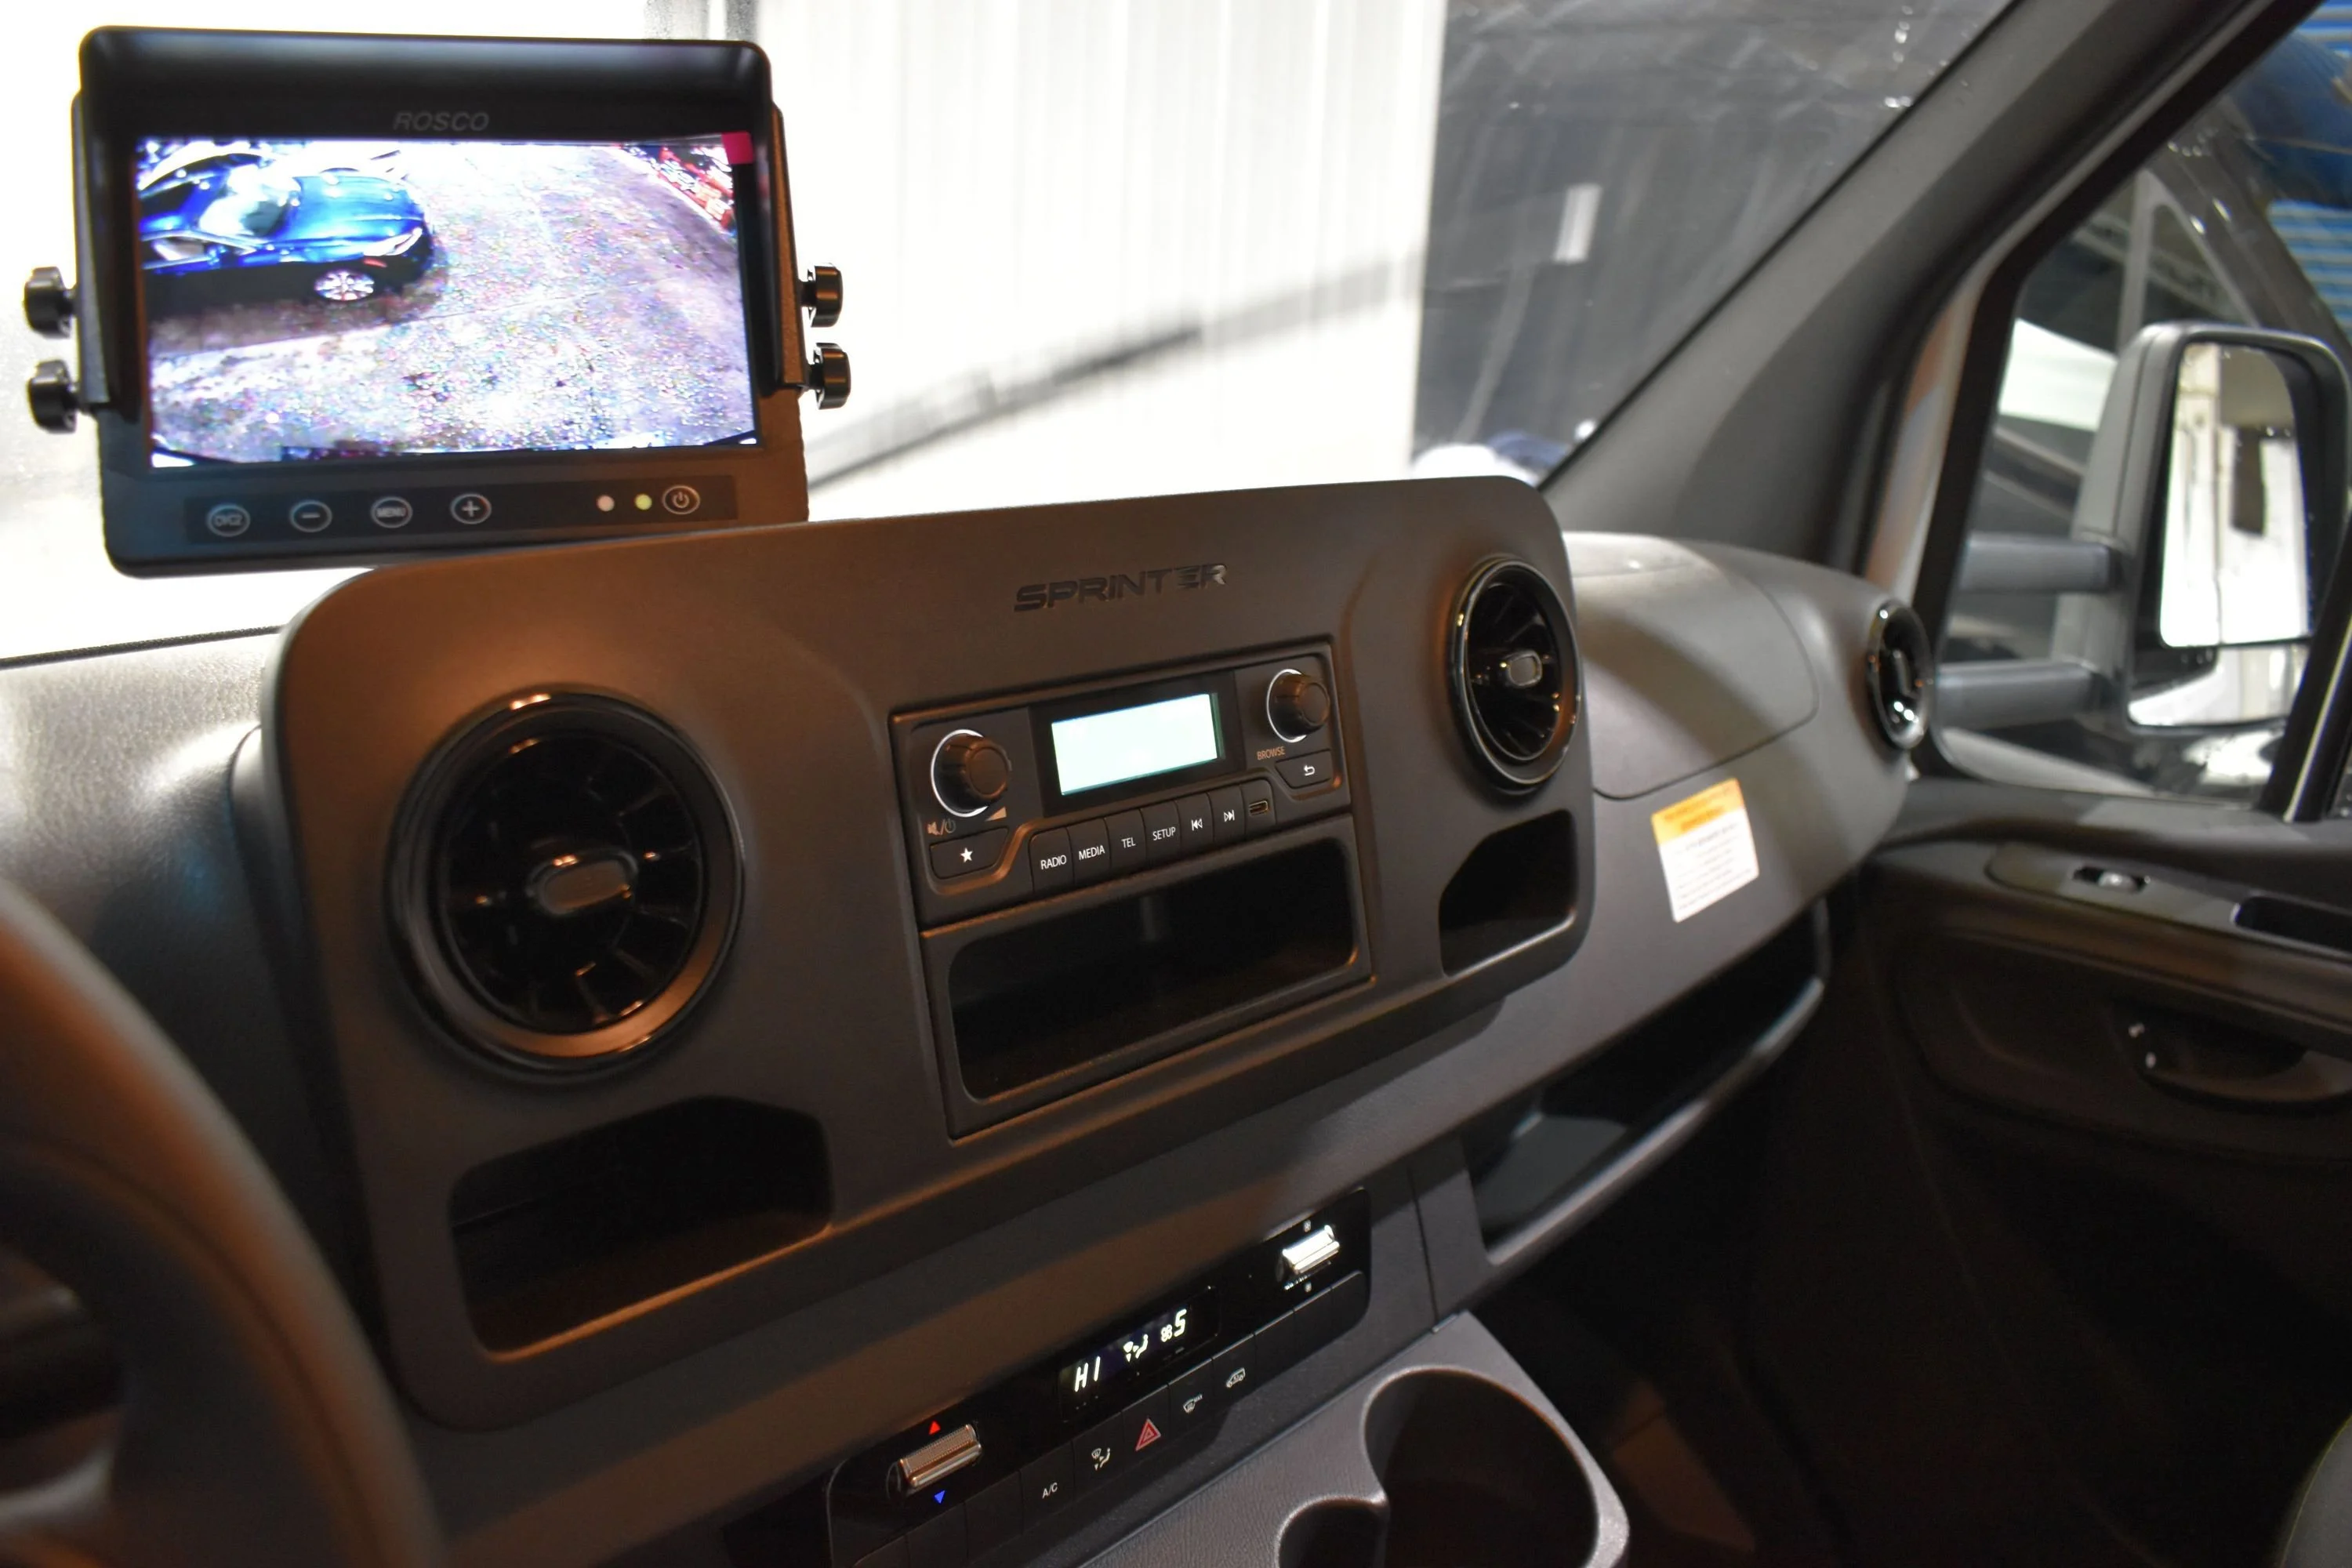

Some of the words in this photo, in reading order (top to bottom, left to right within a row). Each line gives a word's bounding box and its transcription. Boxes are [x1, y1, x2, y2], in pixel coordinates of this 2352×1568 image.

[393, 111, 490, 131] ROSCO
[1014, 562, 1228, 612] SPRINTER
[1257, 746, 1287, 760] BROWSE
[1152, 826, 1177, 841] SETUP
[1121, 837, 1136, 849] TEL
[1078, 844, 1105, 861] MEDIA
[1040, 855, 1067, 870] RADIO
[1074, 1356, 1101, 1392] HI
[1041, 1482, 1058, 1499] A/C
